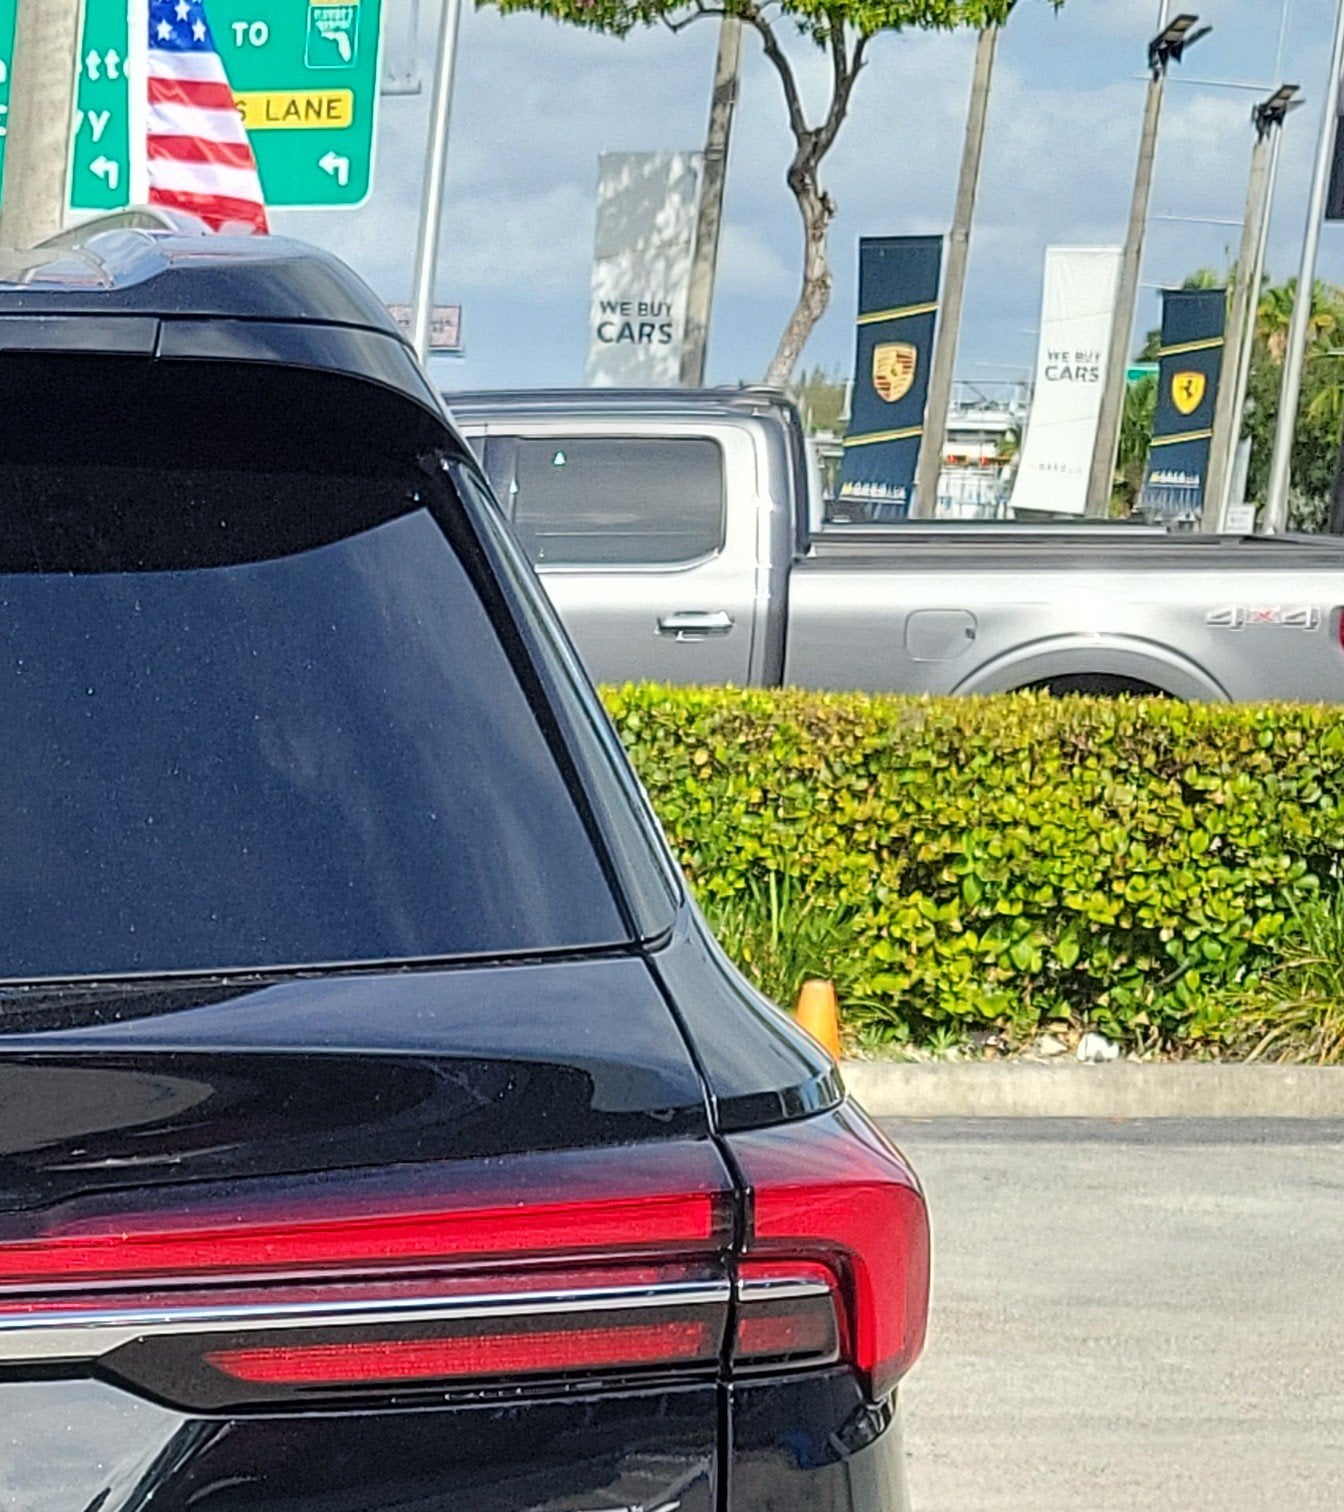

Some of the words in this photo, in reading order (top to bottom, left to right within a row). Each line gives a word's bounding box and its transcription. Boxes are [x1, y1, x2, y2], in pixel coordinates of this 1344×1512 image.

[232, 20, 269, 47] TO
[265, 97, 343, 122] LANE
[599, 300, 633, 316] WE
[637, 301, 673, 318] BUY
[596, 320, 673, 345] CARS
[1047, 350, 1070, 363] WE
[1044, 364, 1100, 383] CARS
